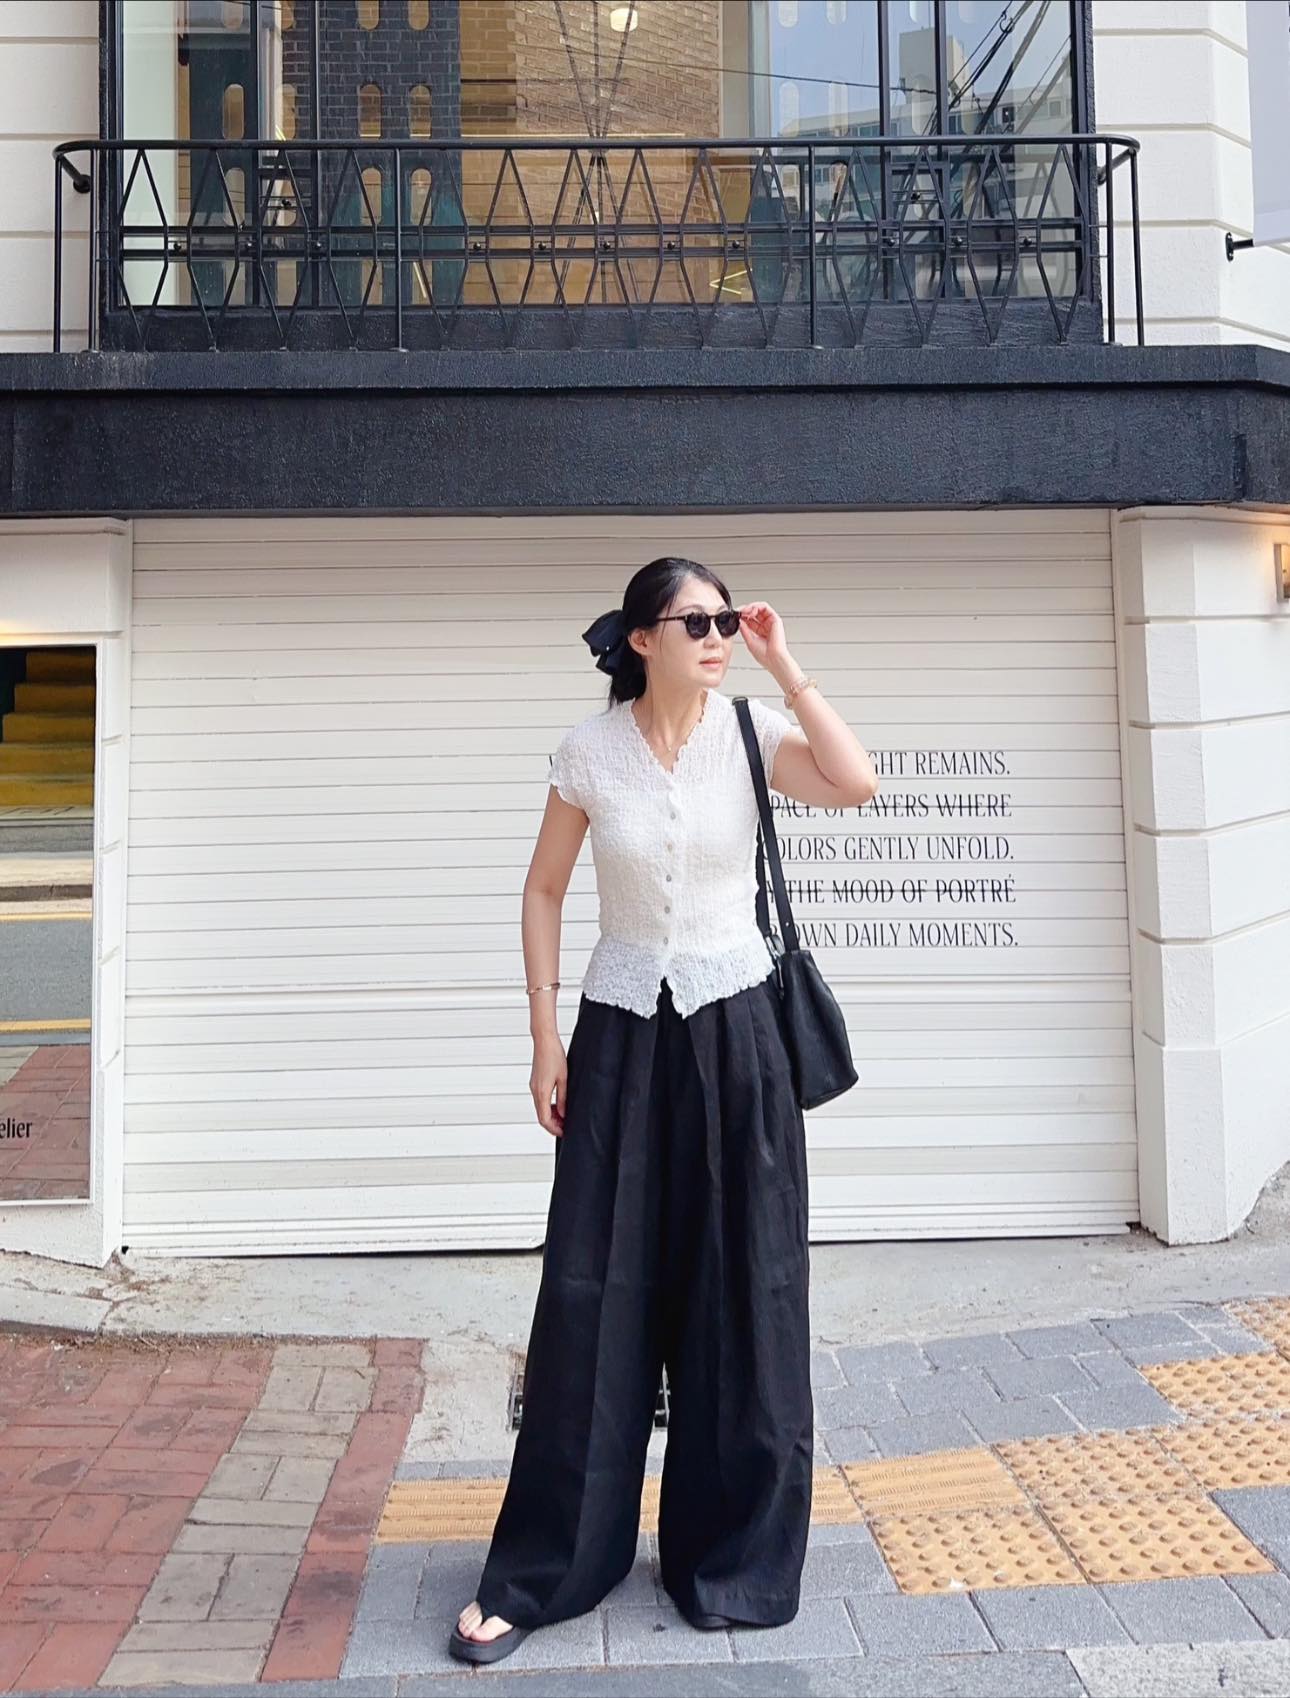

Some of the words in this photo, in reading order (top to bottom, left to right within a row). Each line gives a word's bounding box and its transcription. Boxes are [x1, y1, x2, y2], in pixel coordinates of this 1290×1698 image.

[915, 751, 1011, 775] REMAINS.
[936, 793, 1012, 817] WHERE
[844, 836, 918, 860] GENTLY
[927, 836, 1014, 860] UNFOLD.
[784, 879, 825, 903] THE
[832, 879, 893, 903] MOOD
[901, 879, 928, 903] OF
[936, 873, 1016, 903] PORTRÉ
[846, 922, 901, 947] DAILY
[909, 922, 1019, 947] MOMENTS.
